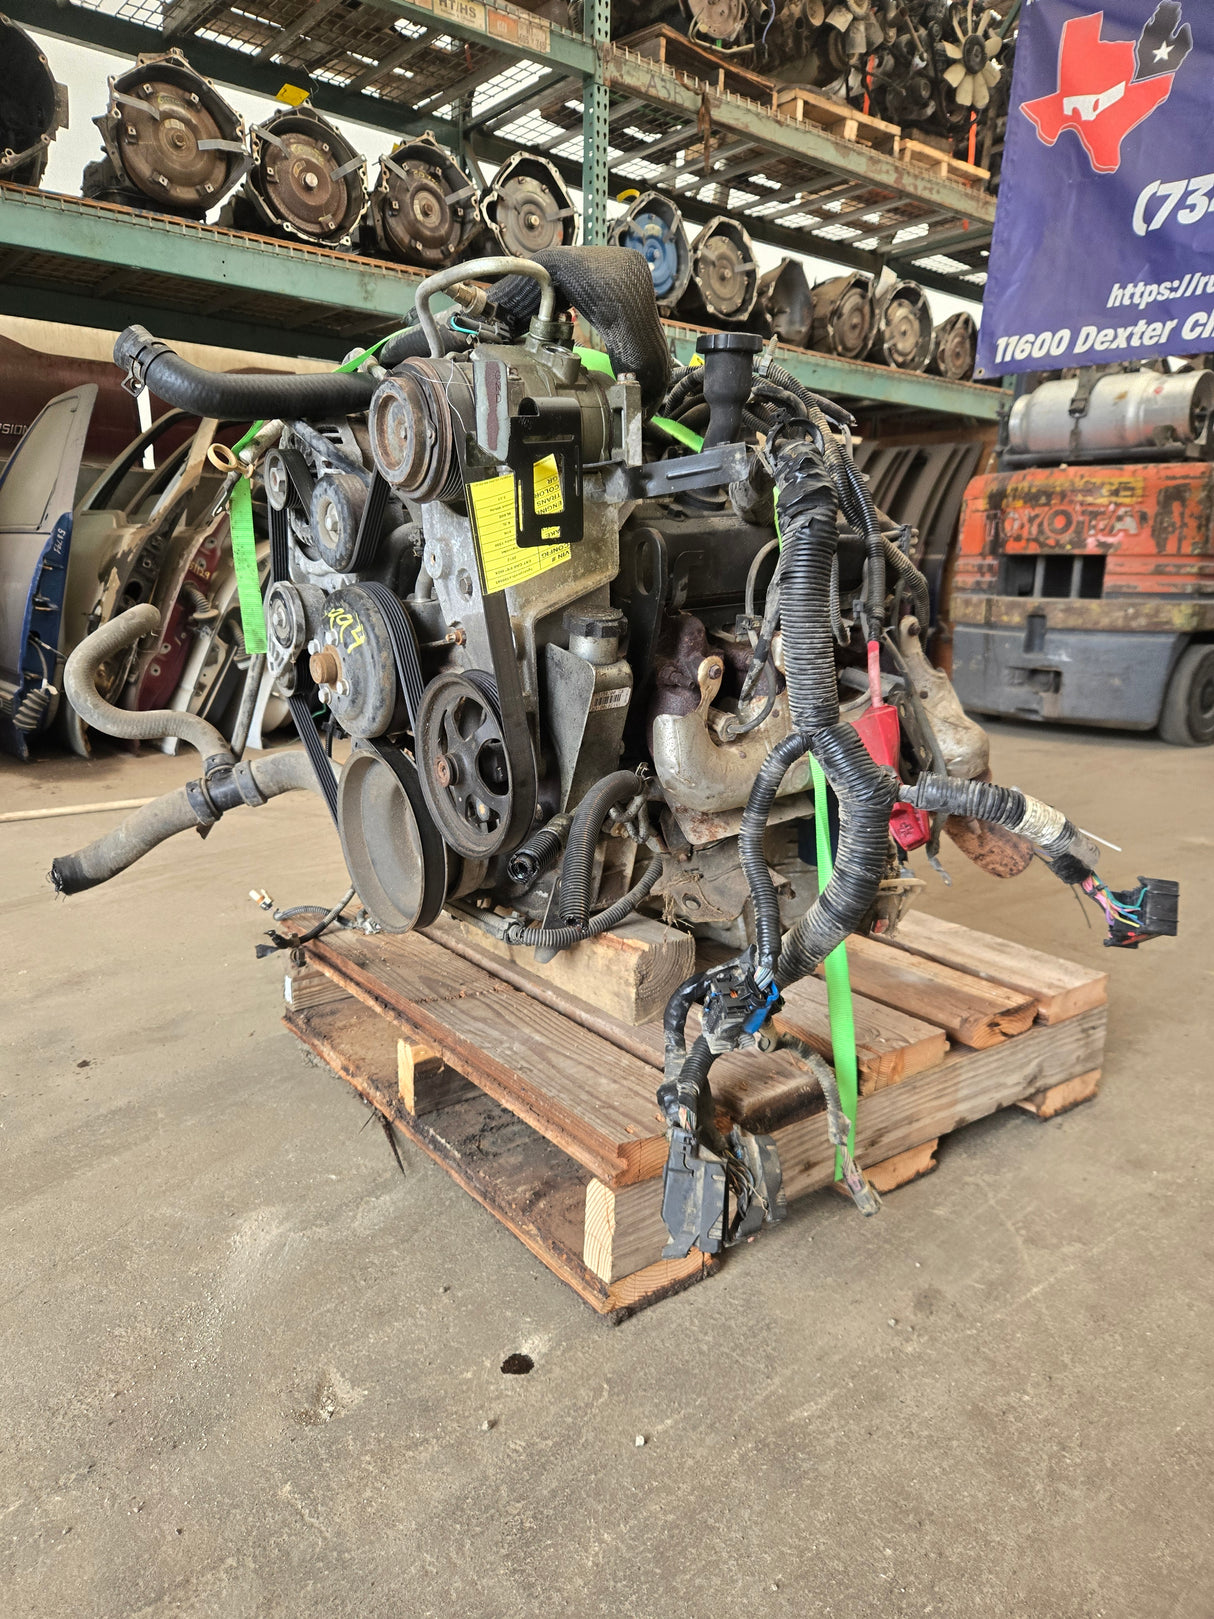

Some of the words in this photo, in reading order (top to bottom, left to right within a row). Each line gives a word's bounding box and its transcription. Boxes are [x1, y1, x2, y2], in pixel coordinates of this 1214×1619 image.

[1132, 173, 1214, 237] (73
[995, 328, 1071, 364] 11600
[1073, 319, 1179, 354] Dexter
[536, 493, 561, 507] TRANS
[984, 505, 1139, 540] TOYOTA
[557, 550, 570, 559] VIN
